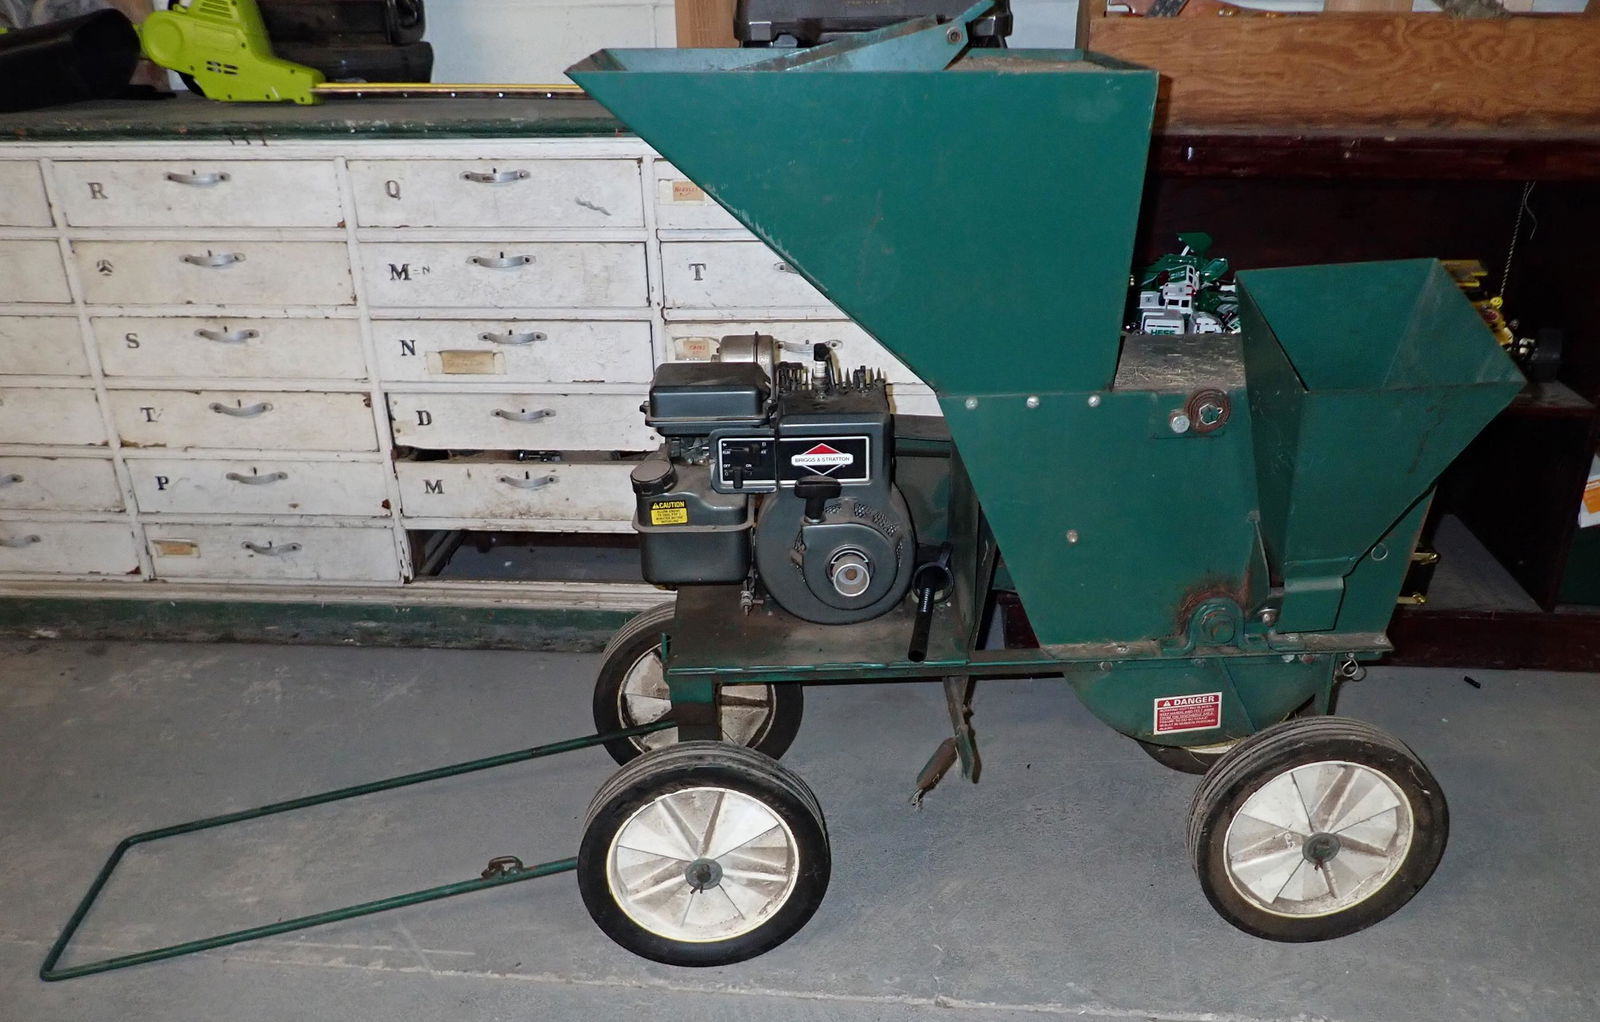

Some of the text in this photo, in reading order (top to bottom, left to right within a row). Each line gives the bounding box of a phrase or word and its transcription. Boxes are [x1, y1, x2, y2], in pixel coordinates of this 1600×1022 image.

[88, 183, 108, 200] R
[384, 180, 401, 201] Q
[387, 264, 412, 281] M
[688, 262, 707, 281] T
[125, 332, 140, 349] S
[398, 340, 417, 357] N
[141, 407, 157, 423] T
[415, 410, 433, 427] D
[155, 475, 170, 491] P
[423, 479, 445, 495] M
[659, 501, 685, 509] CAUTION
[1173, 695, 1215, 706] DANGER
